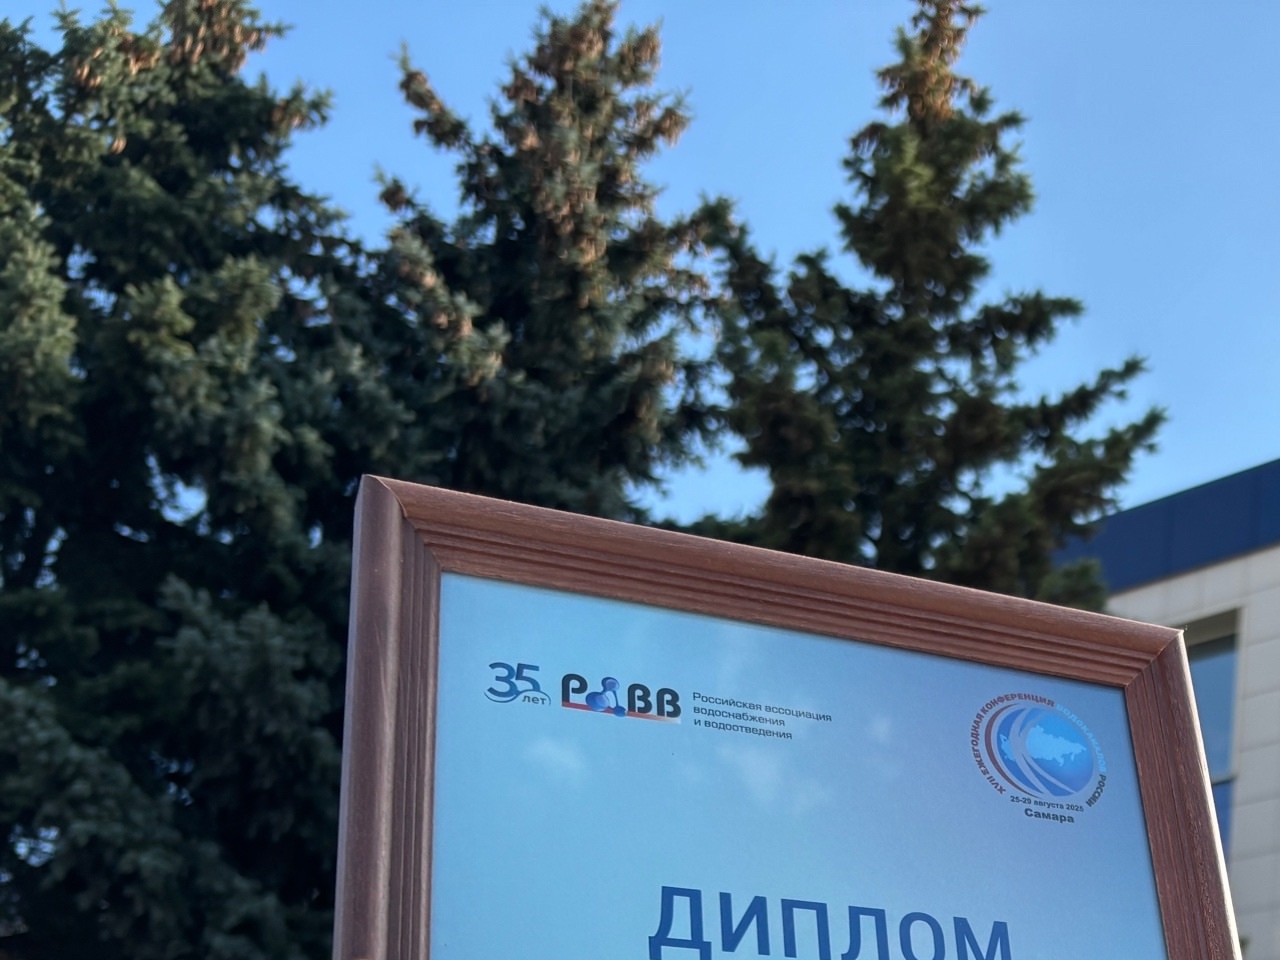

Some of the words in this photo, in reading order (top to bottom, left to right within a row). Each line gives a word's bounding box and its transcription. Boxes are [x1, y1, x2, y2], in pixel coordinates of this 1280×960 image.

[487, 661, 541, 698] 35
[522, 695, 547, 705] лет
[692, 692, 762, 711] Российская
[764, 702, 833, 722] ассоциация
[693, 707, 786, 727] водоснабжения
[694, 719, 701, 727] и
[704, 720, 793, 740] водоотведения
[970, 713, 990, 776] ЕЖЕГОДНАЯ
[981, 693, 1055, 715] КОНФЕРЕНЦИЯ
[1085, 774, 1107, 808] РОССИИ
[1024, 807, 1075, 824] Самара
[1033, 799, 1064, 810] августа
[1066, 802, 1084, 812] 2025
